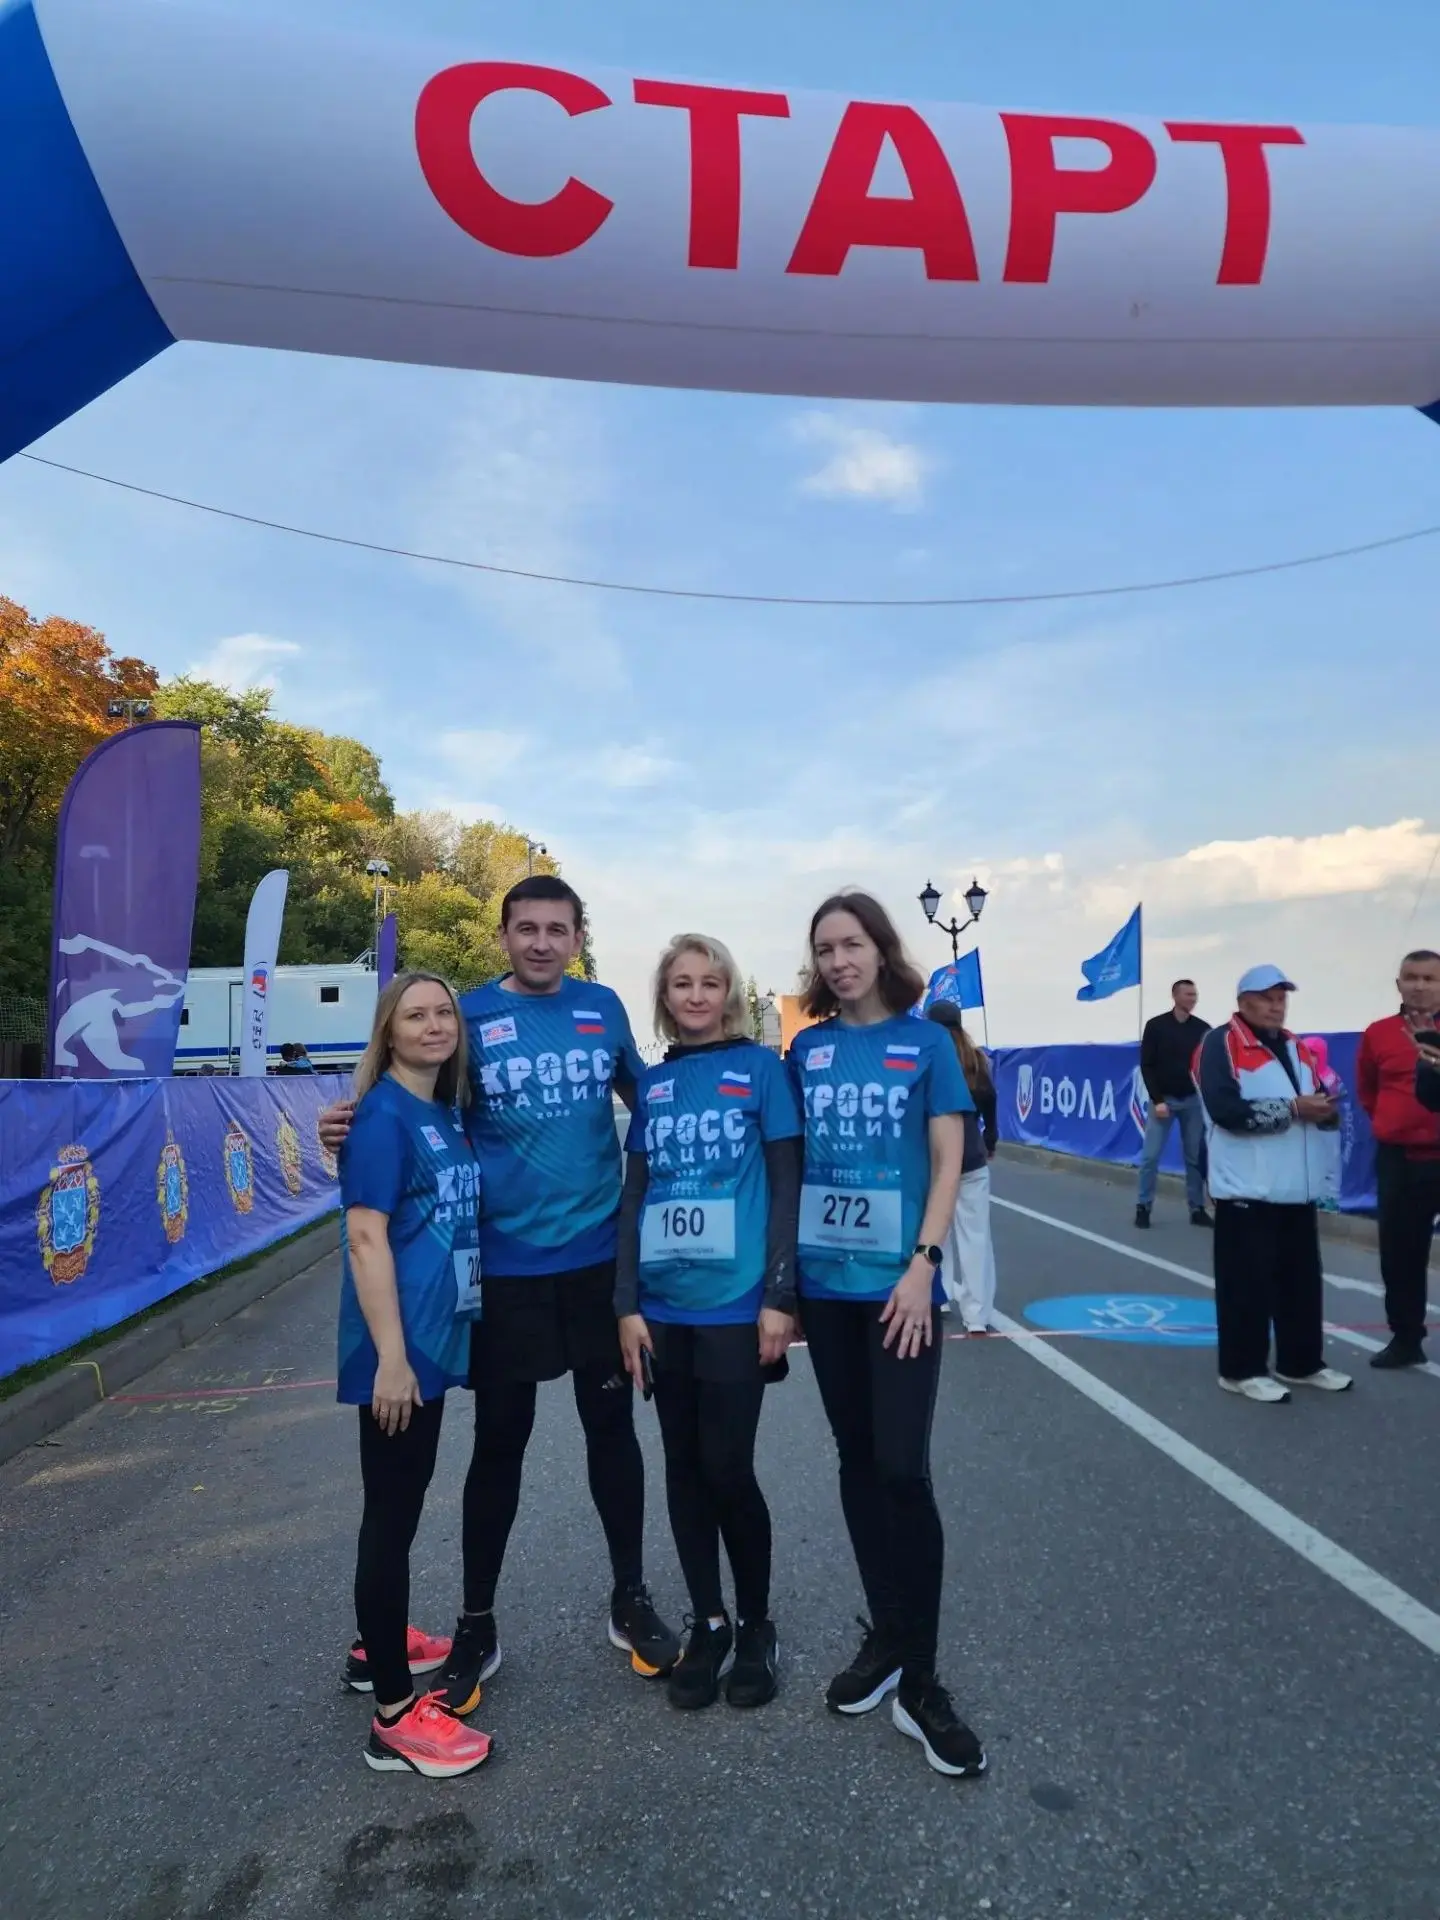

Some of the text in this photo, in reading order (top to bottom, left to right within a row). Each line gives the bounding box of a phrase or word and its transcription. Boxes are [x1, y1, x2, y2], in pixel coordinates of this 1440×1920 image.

[415, 61, 1305, 286] СТАРТ
[480, 1048, 611, 1096] КРОСС
[489, 1084, 607, 1111] НАЦИИ
[1040, 1076, 1117, 1122] ВФЛА
[662, 1207, 705, 1238] 160
[823, 1194, 870, 1228] 272
